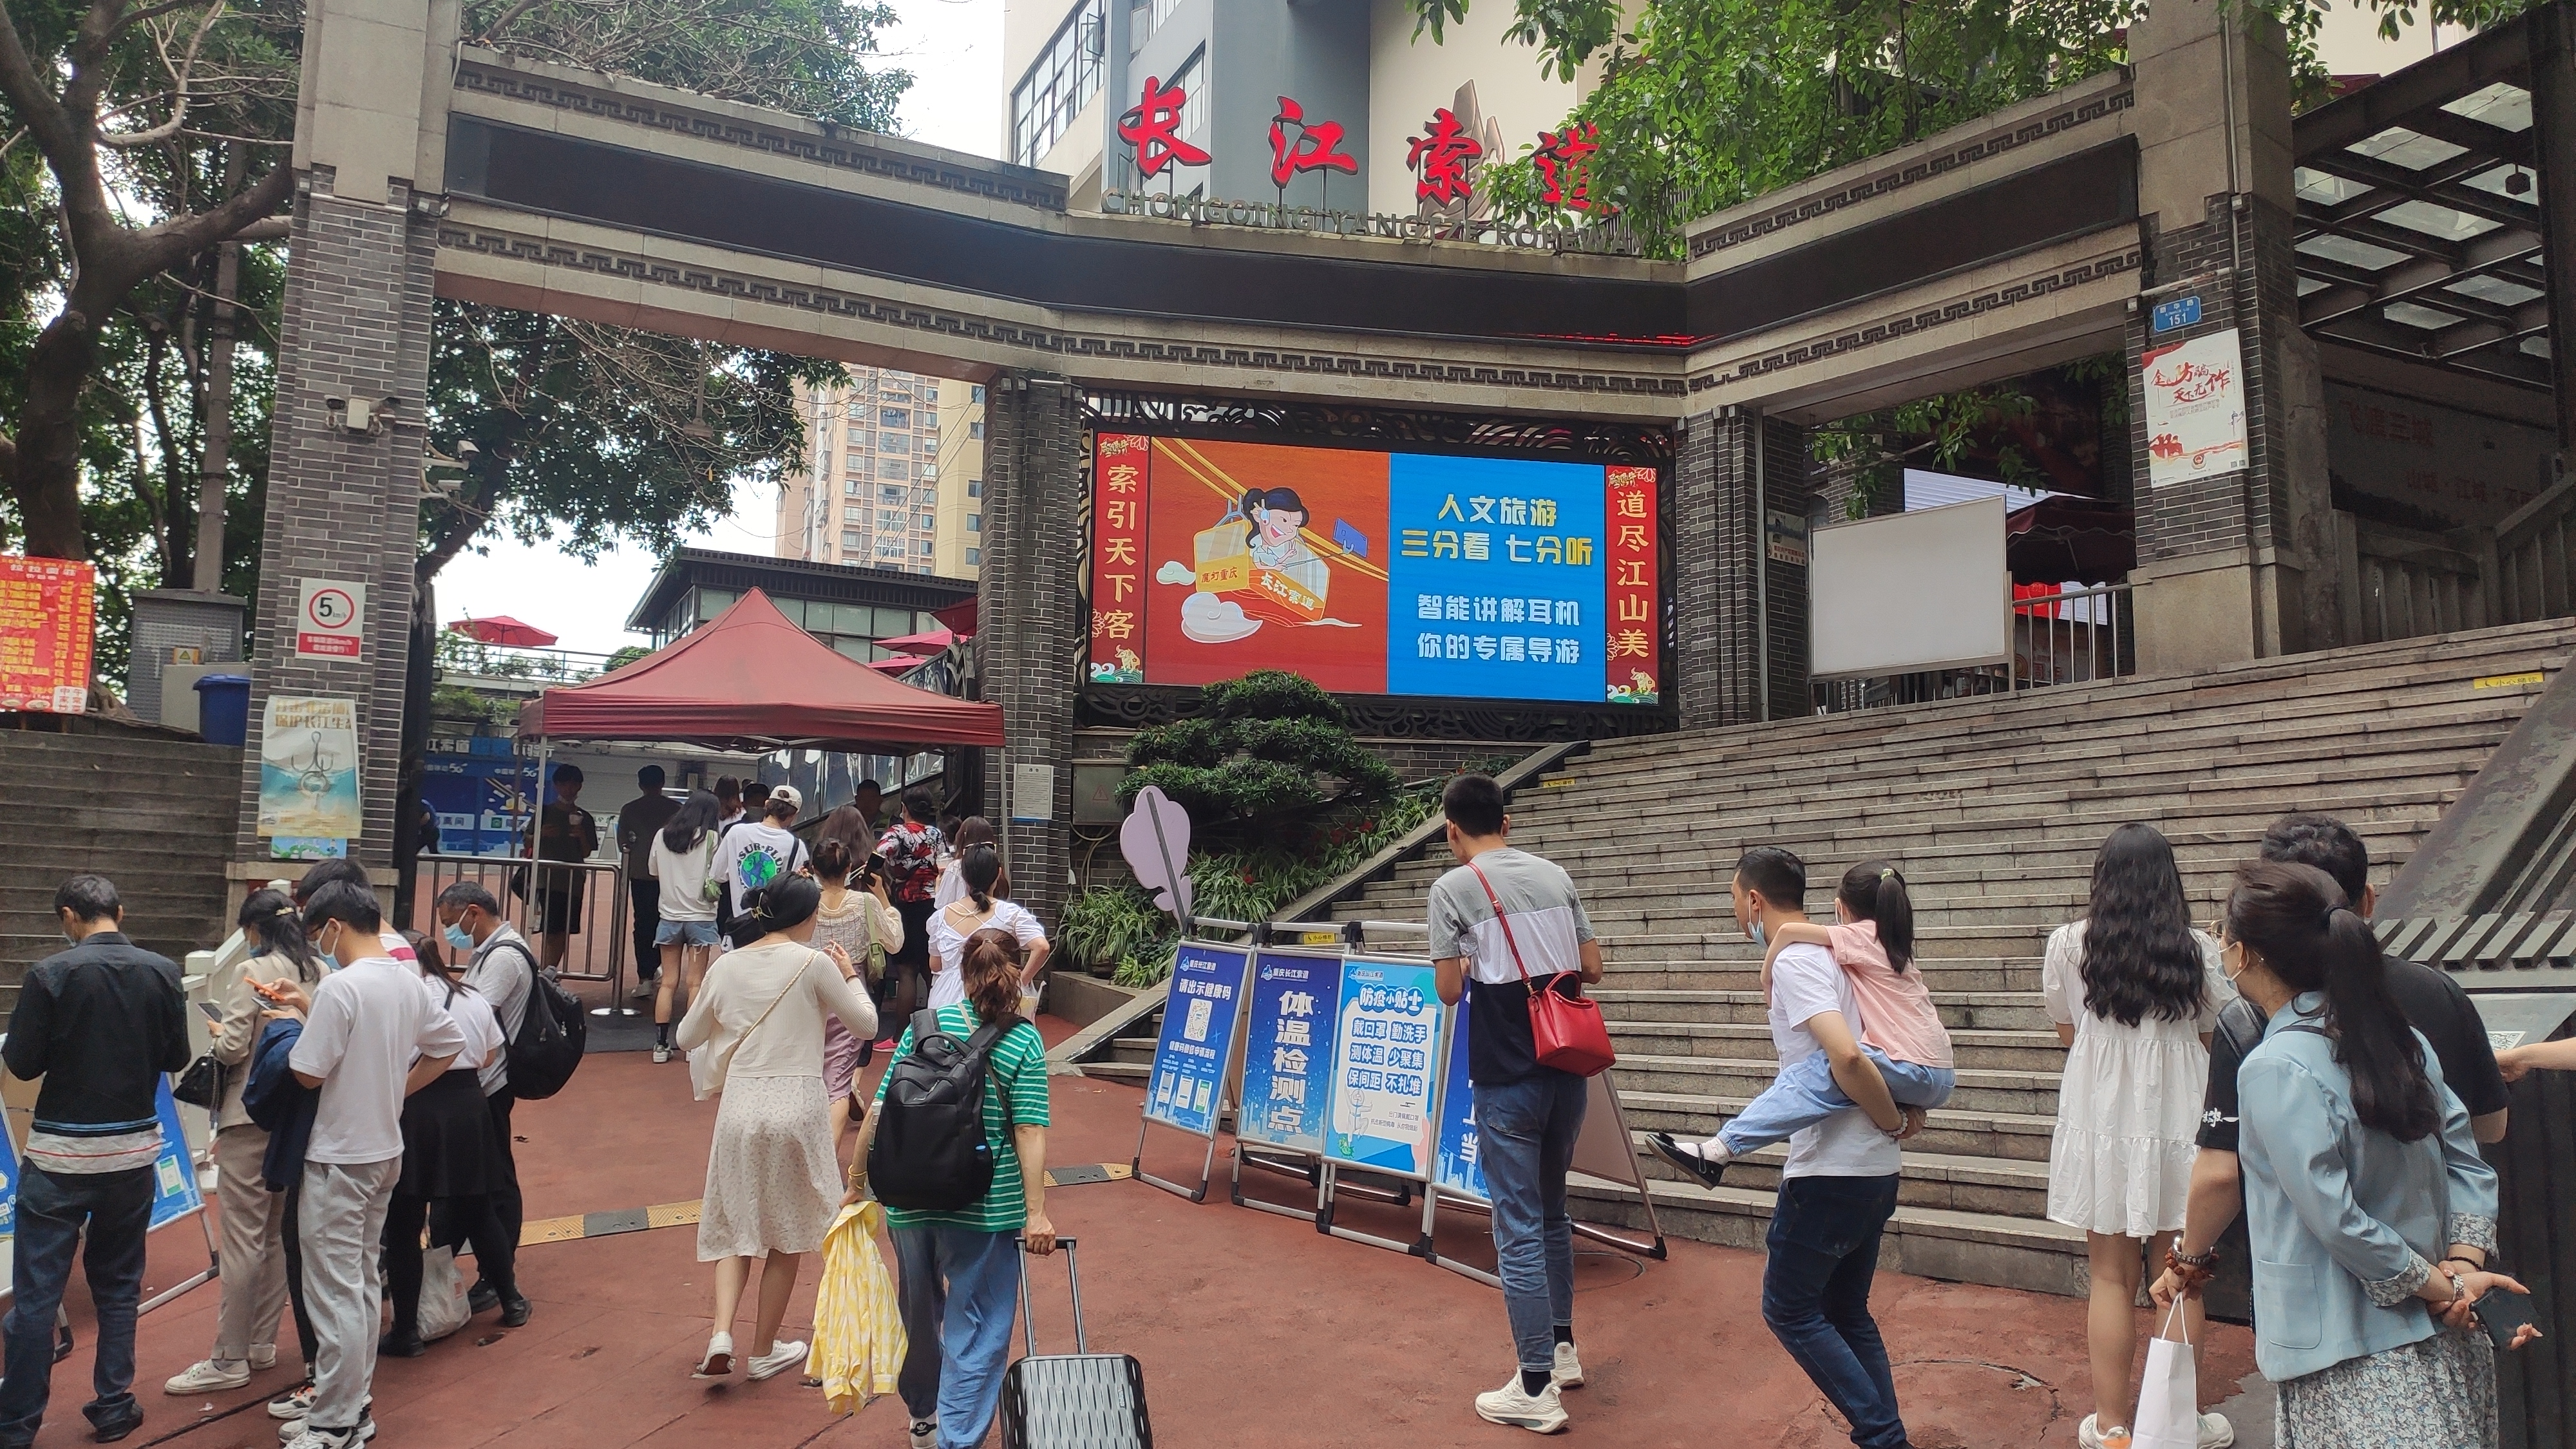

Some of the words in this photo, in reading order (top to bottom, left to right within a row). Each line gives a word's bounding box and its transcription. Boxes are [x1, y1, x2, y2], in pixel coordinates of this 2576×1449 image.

[2169, 312, 2186, 327] 151
[1437, 493, 1557, 527] 人文旅游
[1103, 464, 1139, 640] 索引天下客
[1401, 529, 1490, 561] 三分看
[1505, 534, 1593, 565] 七分听
[1616, 490, 1650, 658] 道尽江山美
[1261, 572, 1316, 611] 长江索道
[319, 596, 333, 617] 5
[1417, 594, 1580, 626] 智能讲解耳机
[1417, 633, 1580, 664] 你的专属导游
[1273, 968, 1309, 980] 重庆长江索道
[1179, 978, 1232, 1001] 请出示健康码
[1359, 987, 1423, 1012] 防疫小贴士
[1352, 1019, 1387, 1038] 戴口罩
[1391, 1023, 1426, 1042] 勤洗手
[1267, 990, 1314, 1135] 体温检测点
[1349, 1045, 1383, 1065] 测体温
[1388, 1049, 1425, 1069] 少聚集
[1347, 1070, 1381, 1092] 保间距
[1385, 1075, 1422, 1096] 不扎堆
